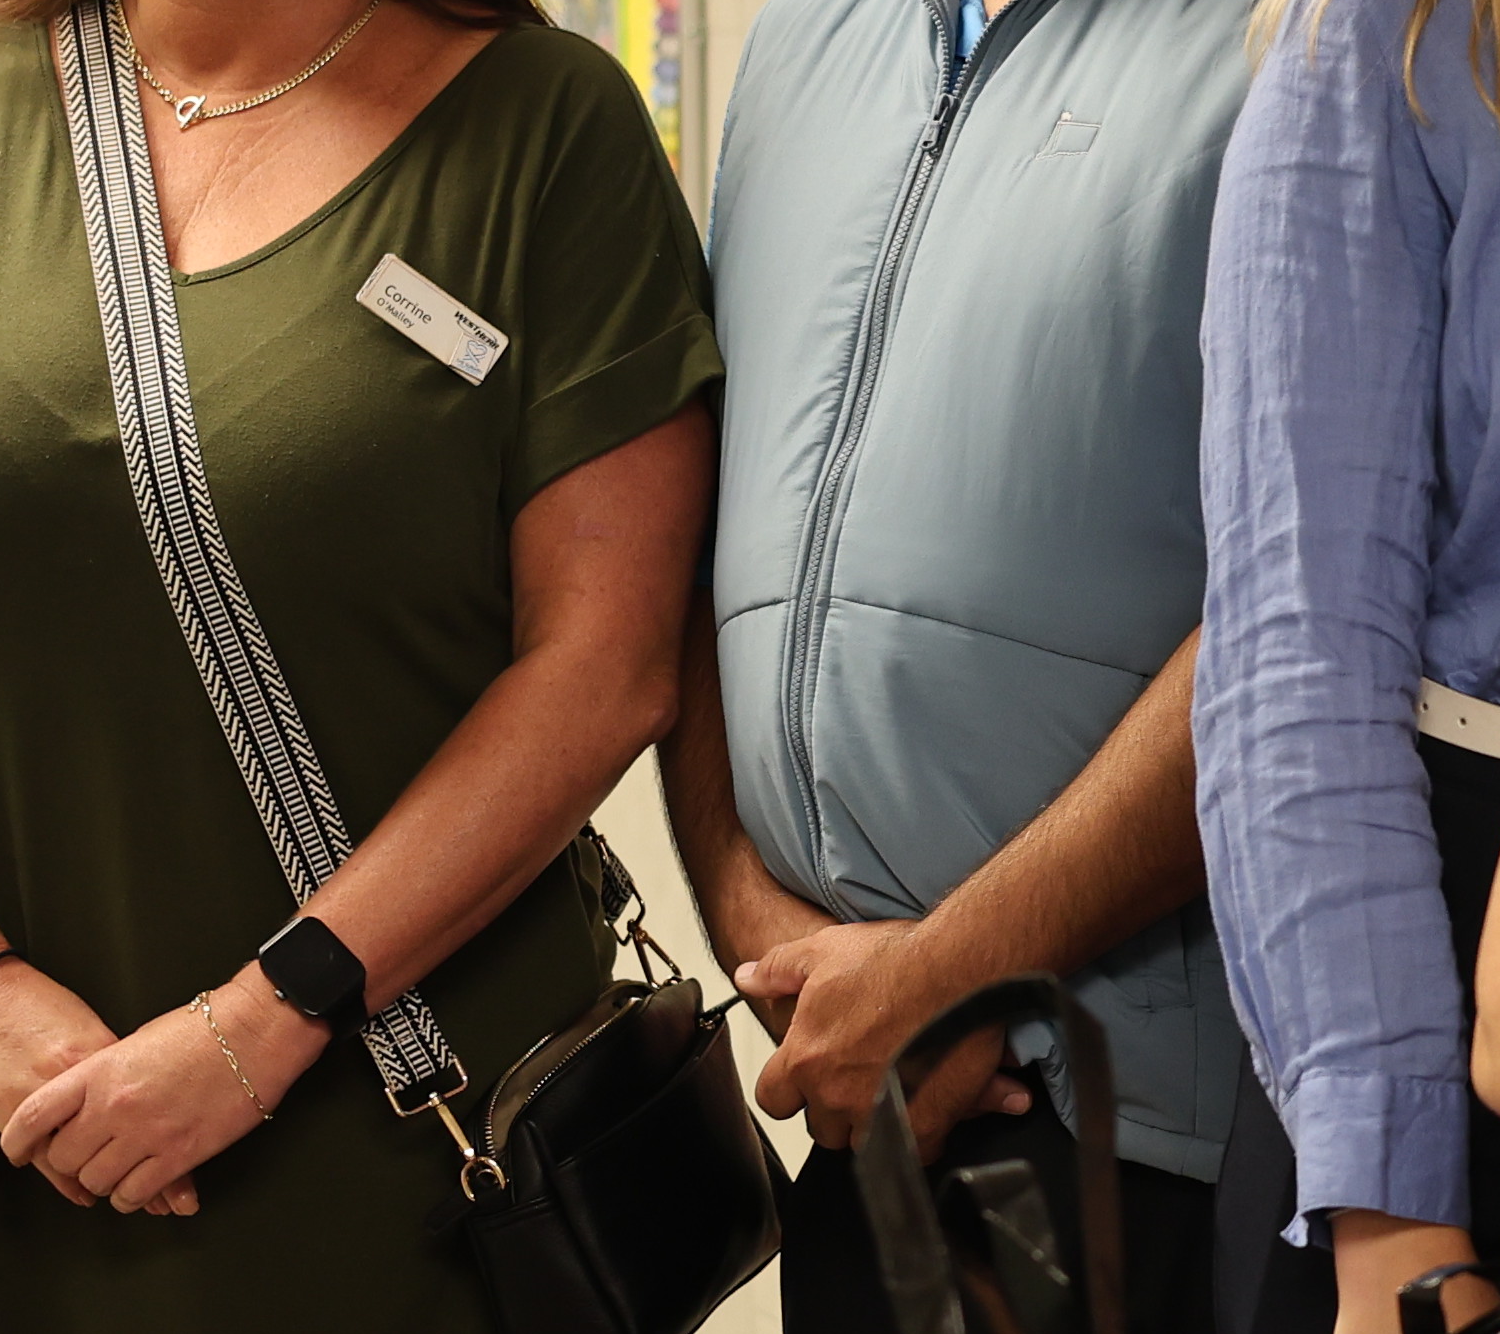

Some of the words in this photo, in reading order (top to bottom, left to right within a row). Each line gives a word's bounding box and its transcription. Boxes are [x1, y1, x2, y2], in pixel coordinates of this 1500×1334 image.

[376, 297, 415, 329] O'Malley
[384, 285, 432, 324] Corrine
[454, 310, 479, 332] WEST
